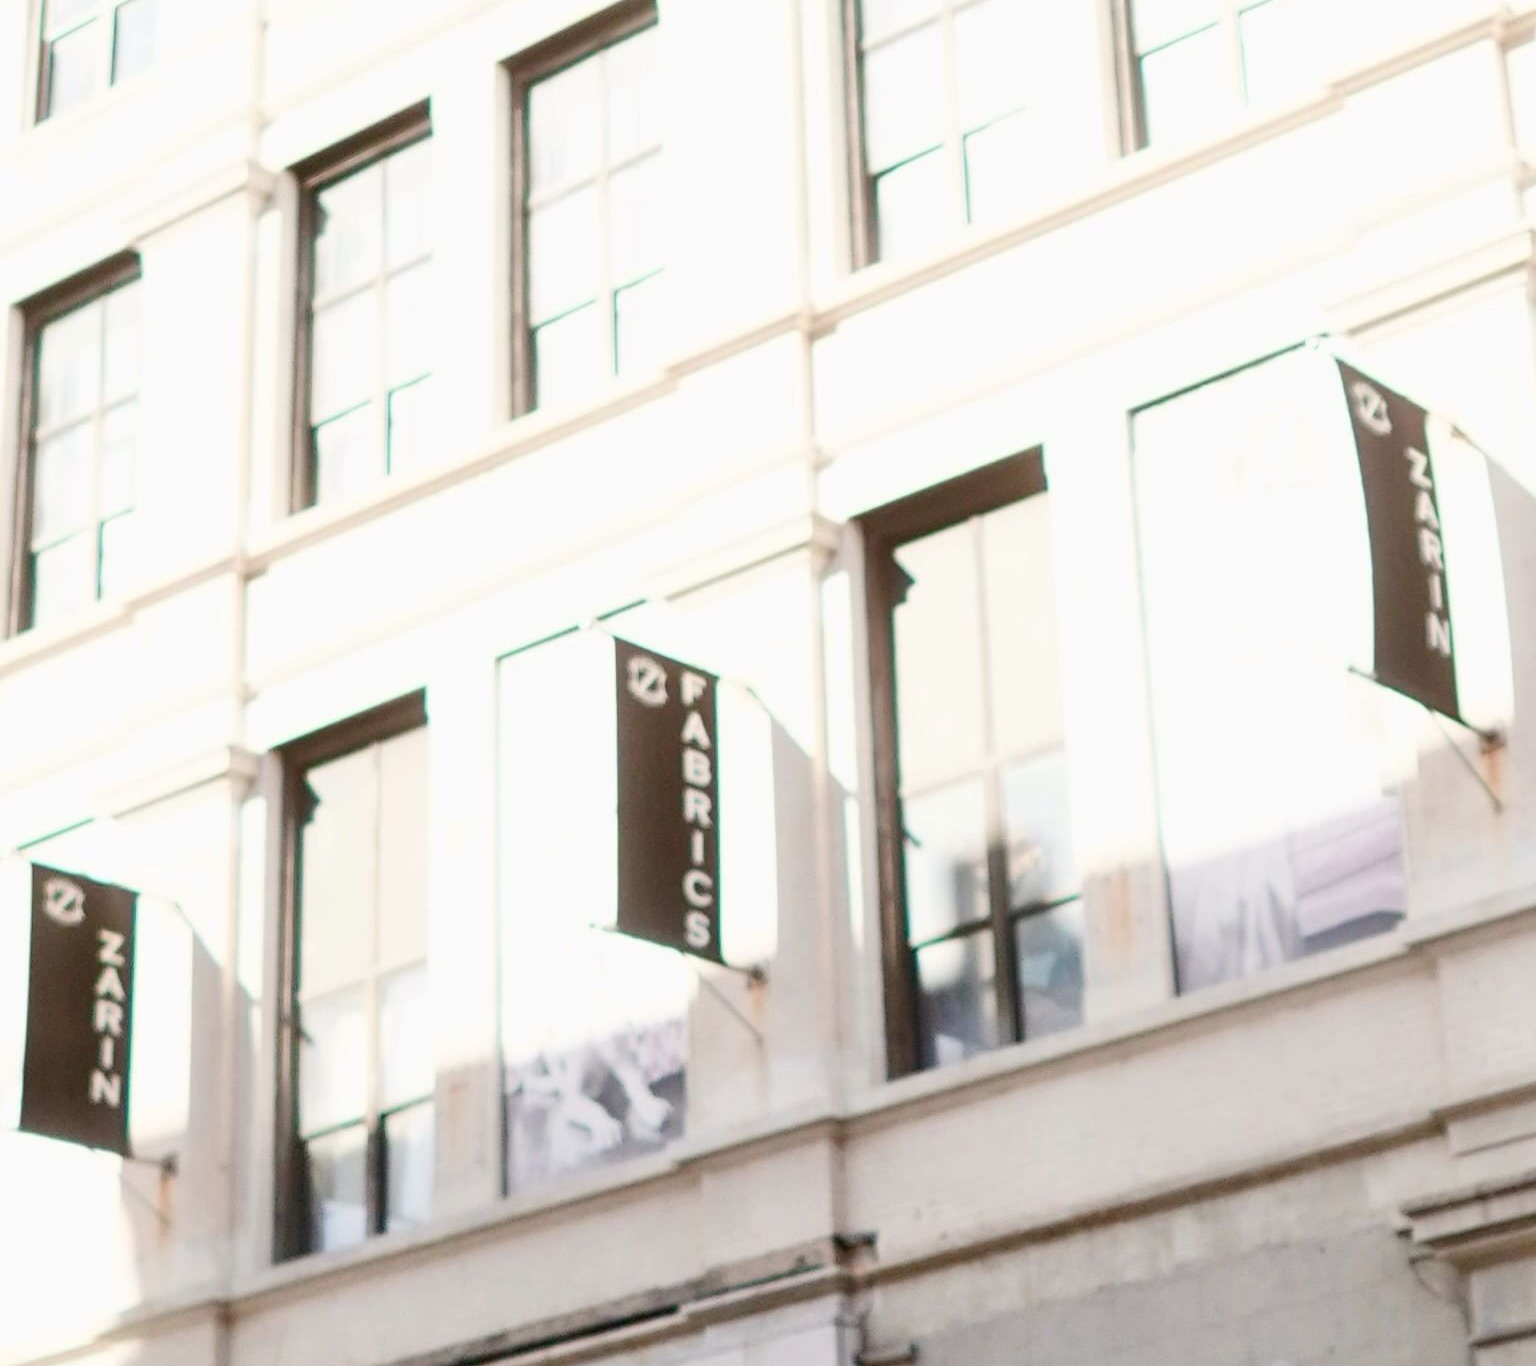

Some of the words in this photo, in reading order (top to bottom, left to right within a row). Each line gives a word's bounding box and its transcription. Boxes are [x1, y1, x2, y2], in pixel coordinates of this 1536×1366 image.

[1403, 446, 1452, 656] ZARIN
[678, 671, 715, 950] FABRICS
[89, 928, 127, 1110] ZARIN
